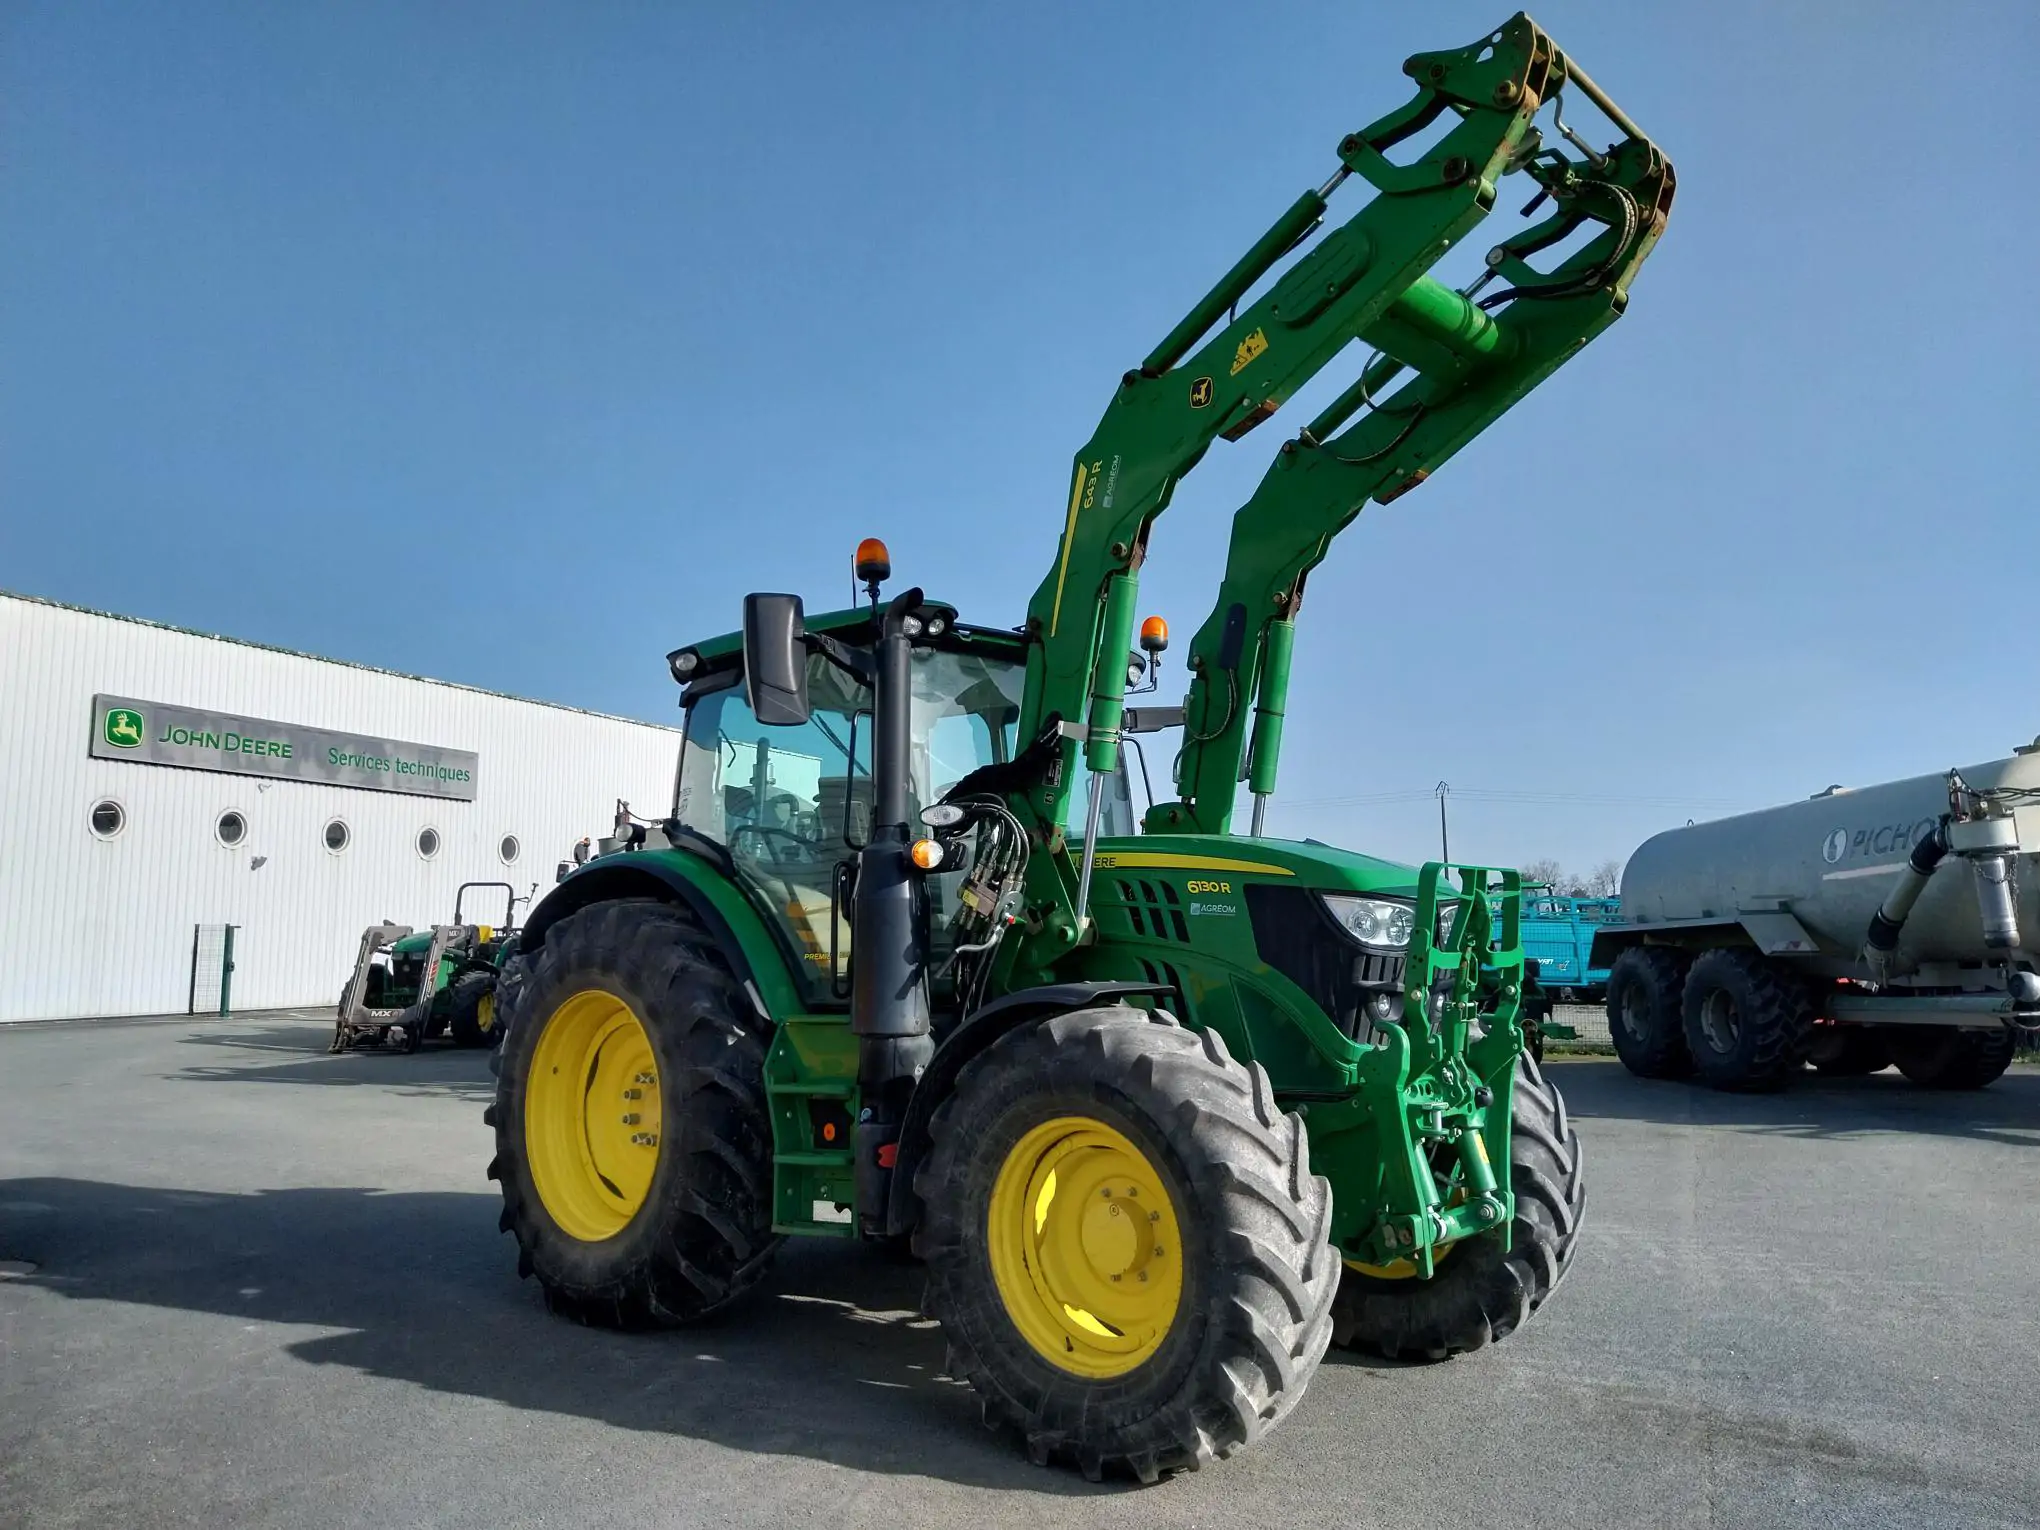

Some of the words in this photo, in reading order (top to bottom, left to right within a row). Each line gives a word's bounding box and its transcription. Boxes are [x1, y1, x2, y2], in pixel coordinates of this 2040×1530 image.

[1084, 477, 1097, 509] 643
[1091, 460, 1103, 474] R
[158, 724, 219, 750] JOHN
[224, 732, 293, 759] DEERE
[328, 747, 390, 772] Services
[395, 757, 471, 783] techniques
[1849, 817, 1936, 858] PICHO
[1187, 880, 1219, 894] 6130
[1220, 882, 1232, 894] R
